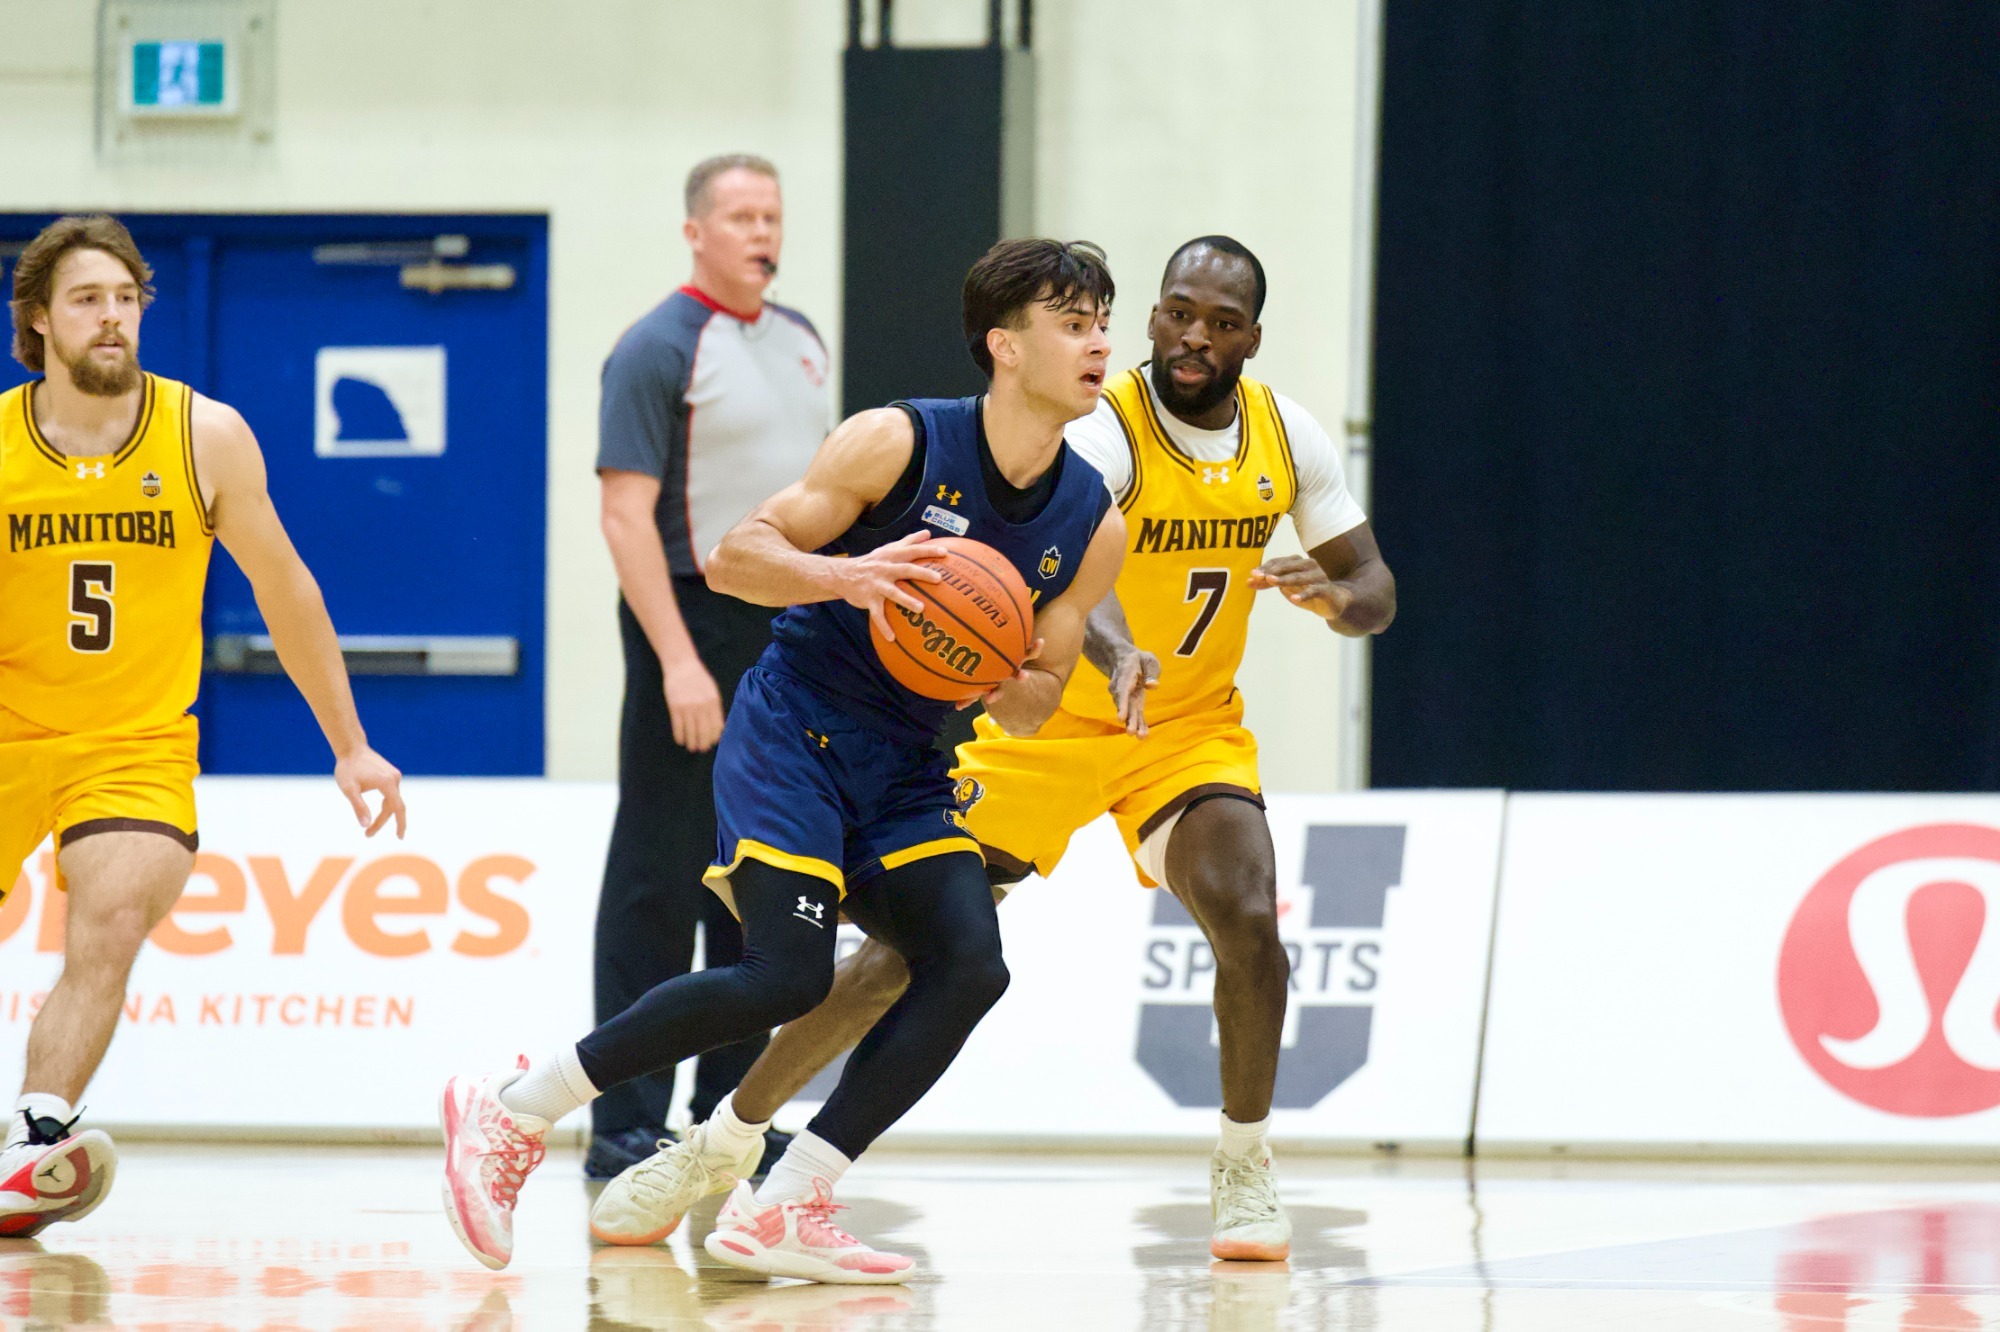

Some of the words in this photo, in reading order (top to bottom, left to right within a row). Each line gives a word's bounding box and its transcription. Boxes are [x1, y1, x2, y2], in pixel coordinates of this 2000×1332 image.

[9, 510, 175, 552] MANITOBA
[931, 516, 961, 533] CROSS
[934, 511, 956, 524] BLUE
[1133, 512, 1280, 553] MANITOBA
[68, 561, 115, 653] 5
[924, 561, 1008, 628] EVOLUTIO
[1174, 568, 1230, 658] 7
[1143, 940, 1381, 992] SPTS
[199, 994, 414, 1027] KITCHEN
